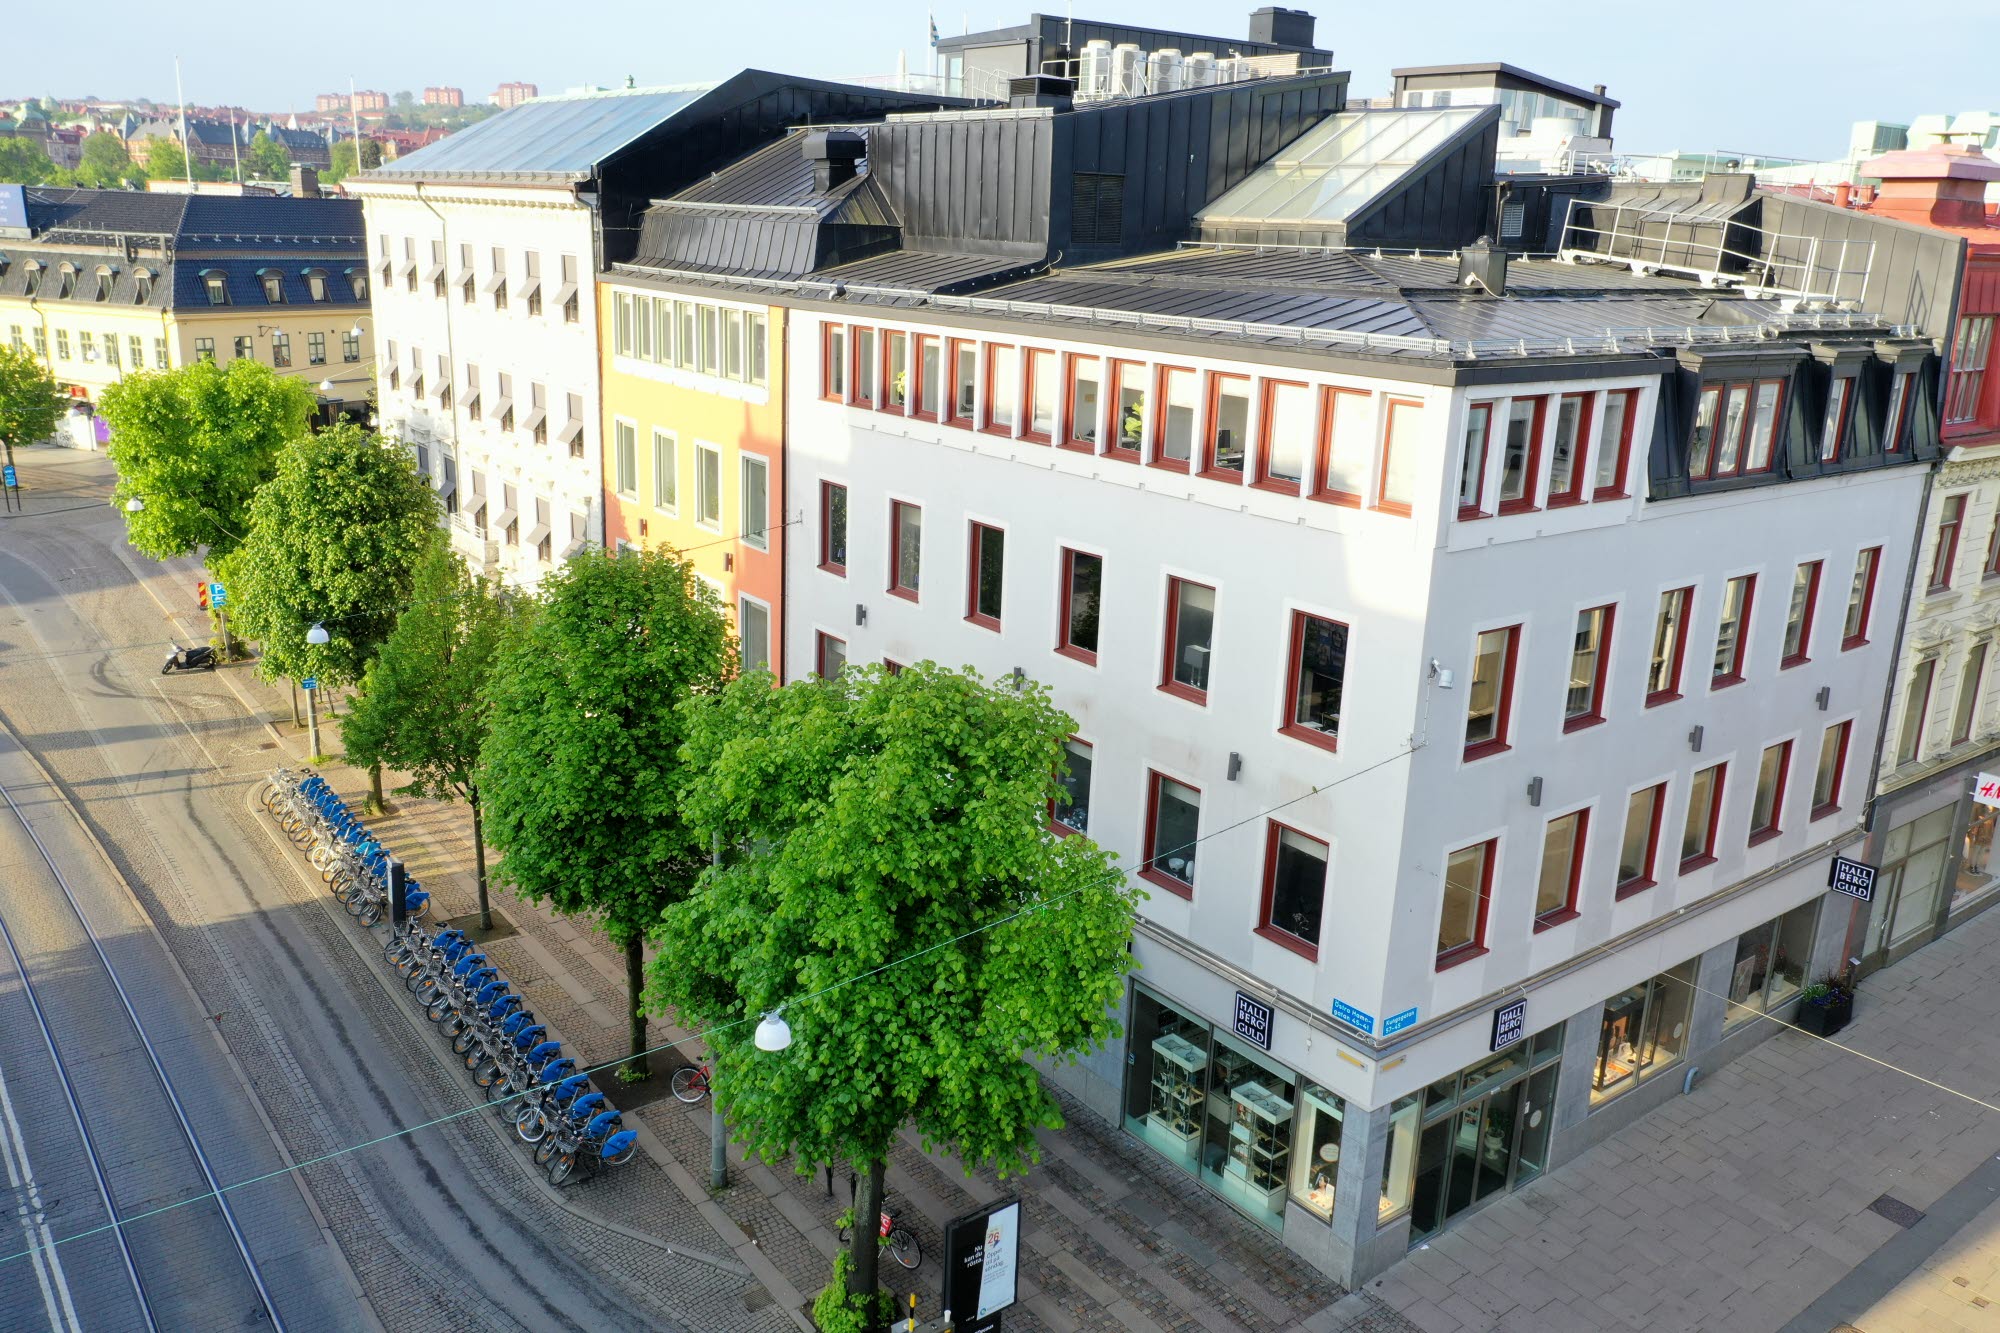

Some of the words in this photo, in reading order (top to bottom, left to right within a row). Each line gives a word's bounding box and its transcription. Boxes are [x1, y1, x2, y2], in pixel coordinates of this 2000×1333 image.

[1841, 863, 1868, 879] HALL
[1837, 881, 1867, 896] GULD
[1240, 999, 1265, 1021] HALL
[1333, 1009, 1351, 1021] gatan
[1334, 1000, 1351, 1014] Östra
[1352, 1009, 1372, 1024] Hamn-
[1501, 1007, 1522, 1024] HALL
[1237, 1022, 1264, 1042] GULD
[1498, 1028, 1520, 1045] GULD
[988, 1232, 999, 1244] 26
[974, 1245, 983, 1253] Nu
[964, 1255, 974, 1263] kan
